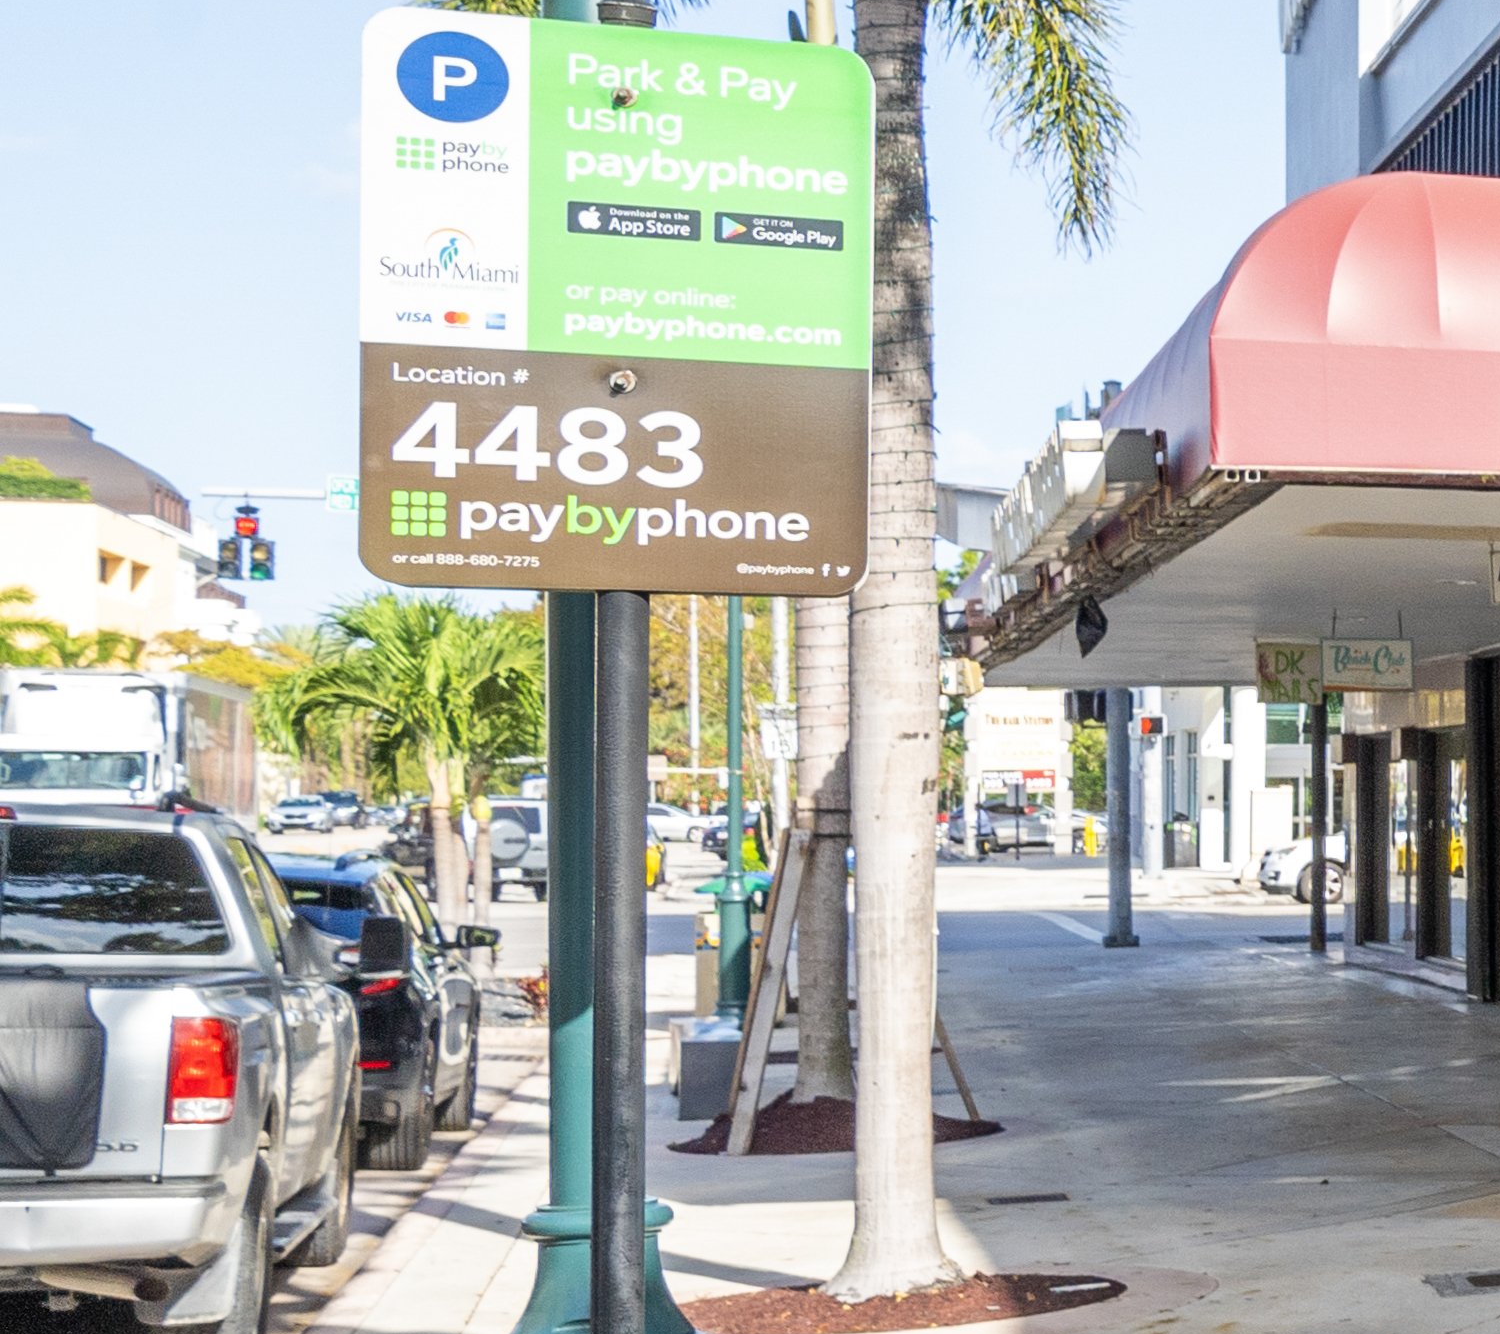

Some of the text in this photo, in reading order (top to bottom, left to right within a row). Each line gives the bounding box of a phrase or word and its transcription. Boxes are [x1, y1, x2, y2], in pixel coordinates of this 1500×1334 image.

[432, 55, 479, 102] P
[567, 53, 797, 110] Park & Pay
[567, 106, 683, 144] using
[442, 140, 508, 159] payby
[442, 157, 510, 175] phone
[566, 150, 848, 195] paybyphone
[609, 207, 690, 221] Download on the
[752, 218, 794, 229] GET IT ON
[608, 219, 691, 237] App Store
[752, 227, 837, 249] Google Play
[380, 256, 519, 284] South Miami
[566, 285, 737, 309] or pay online:
[395, 311, 432, 323] VISA
[564, 311, 842, 346] paybyphone.com
[392, 363, 530, 387] Location #
[391, 400, 704, 489] 4483
[459, 494, 811, 545] paybyphone
[392, 552, 540, 567] or call 888-680-7275
[736, 562, 815, 576] @paybyphone
[1274, 650, 1306, 676] DK
